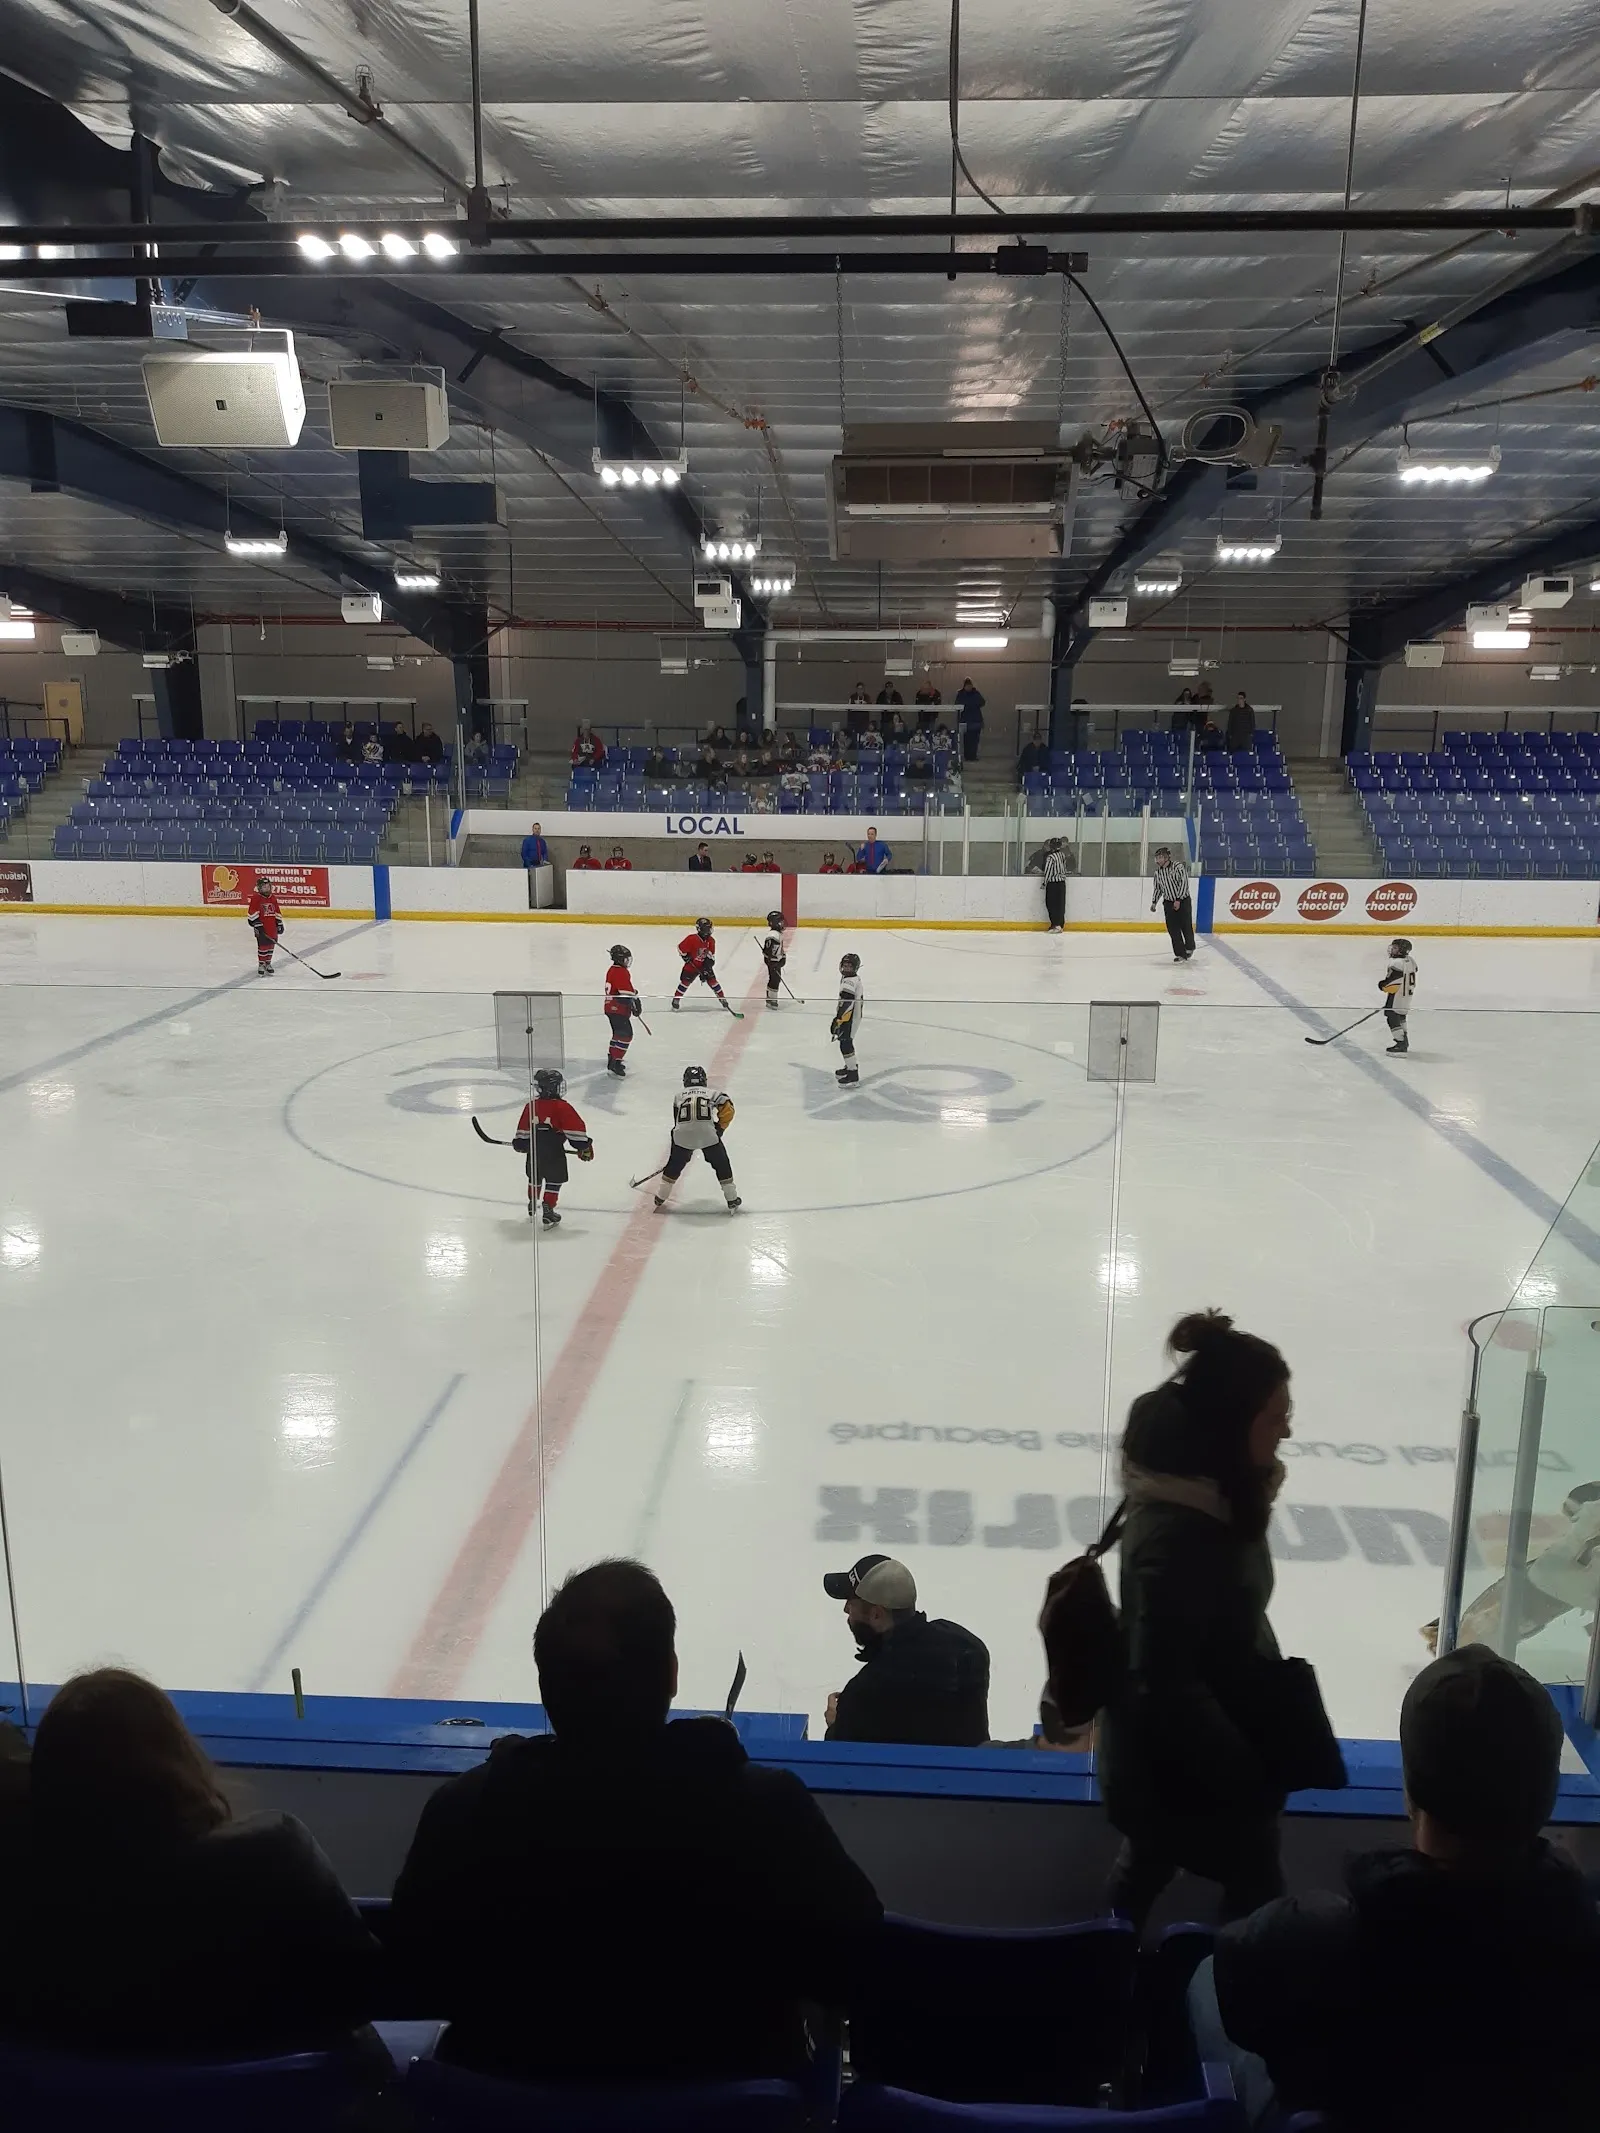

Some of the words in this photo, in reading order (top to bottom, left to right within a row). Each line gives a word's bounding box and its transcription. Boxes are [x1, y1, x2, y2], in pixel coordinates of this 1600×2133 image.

[666, 816, 745, 835] LOCAL
[254, 867, 300, 875] COMPTOIR
[302, 868, 313, 876] ET
[1239, 890, 1260, 900] lait
[1261, 892, 1276, 900] au
[1307, 890, 1327, 900] lait
[1329, 892, 1344, 900] au
[1375, 890, 1396, 900] lait
[1397, 892, 1413, 900] au
[1229, 901, 1278, 911] chocolat
[1297, 901, 1346, 911] chocolat
[1365, 901, 1415, 911] chocolat
